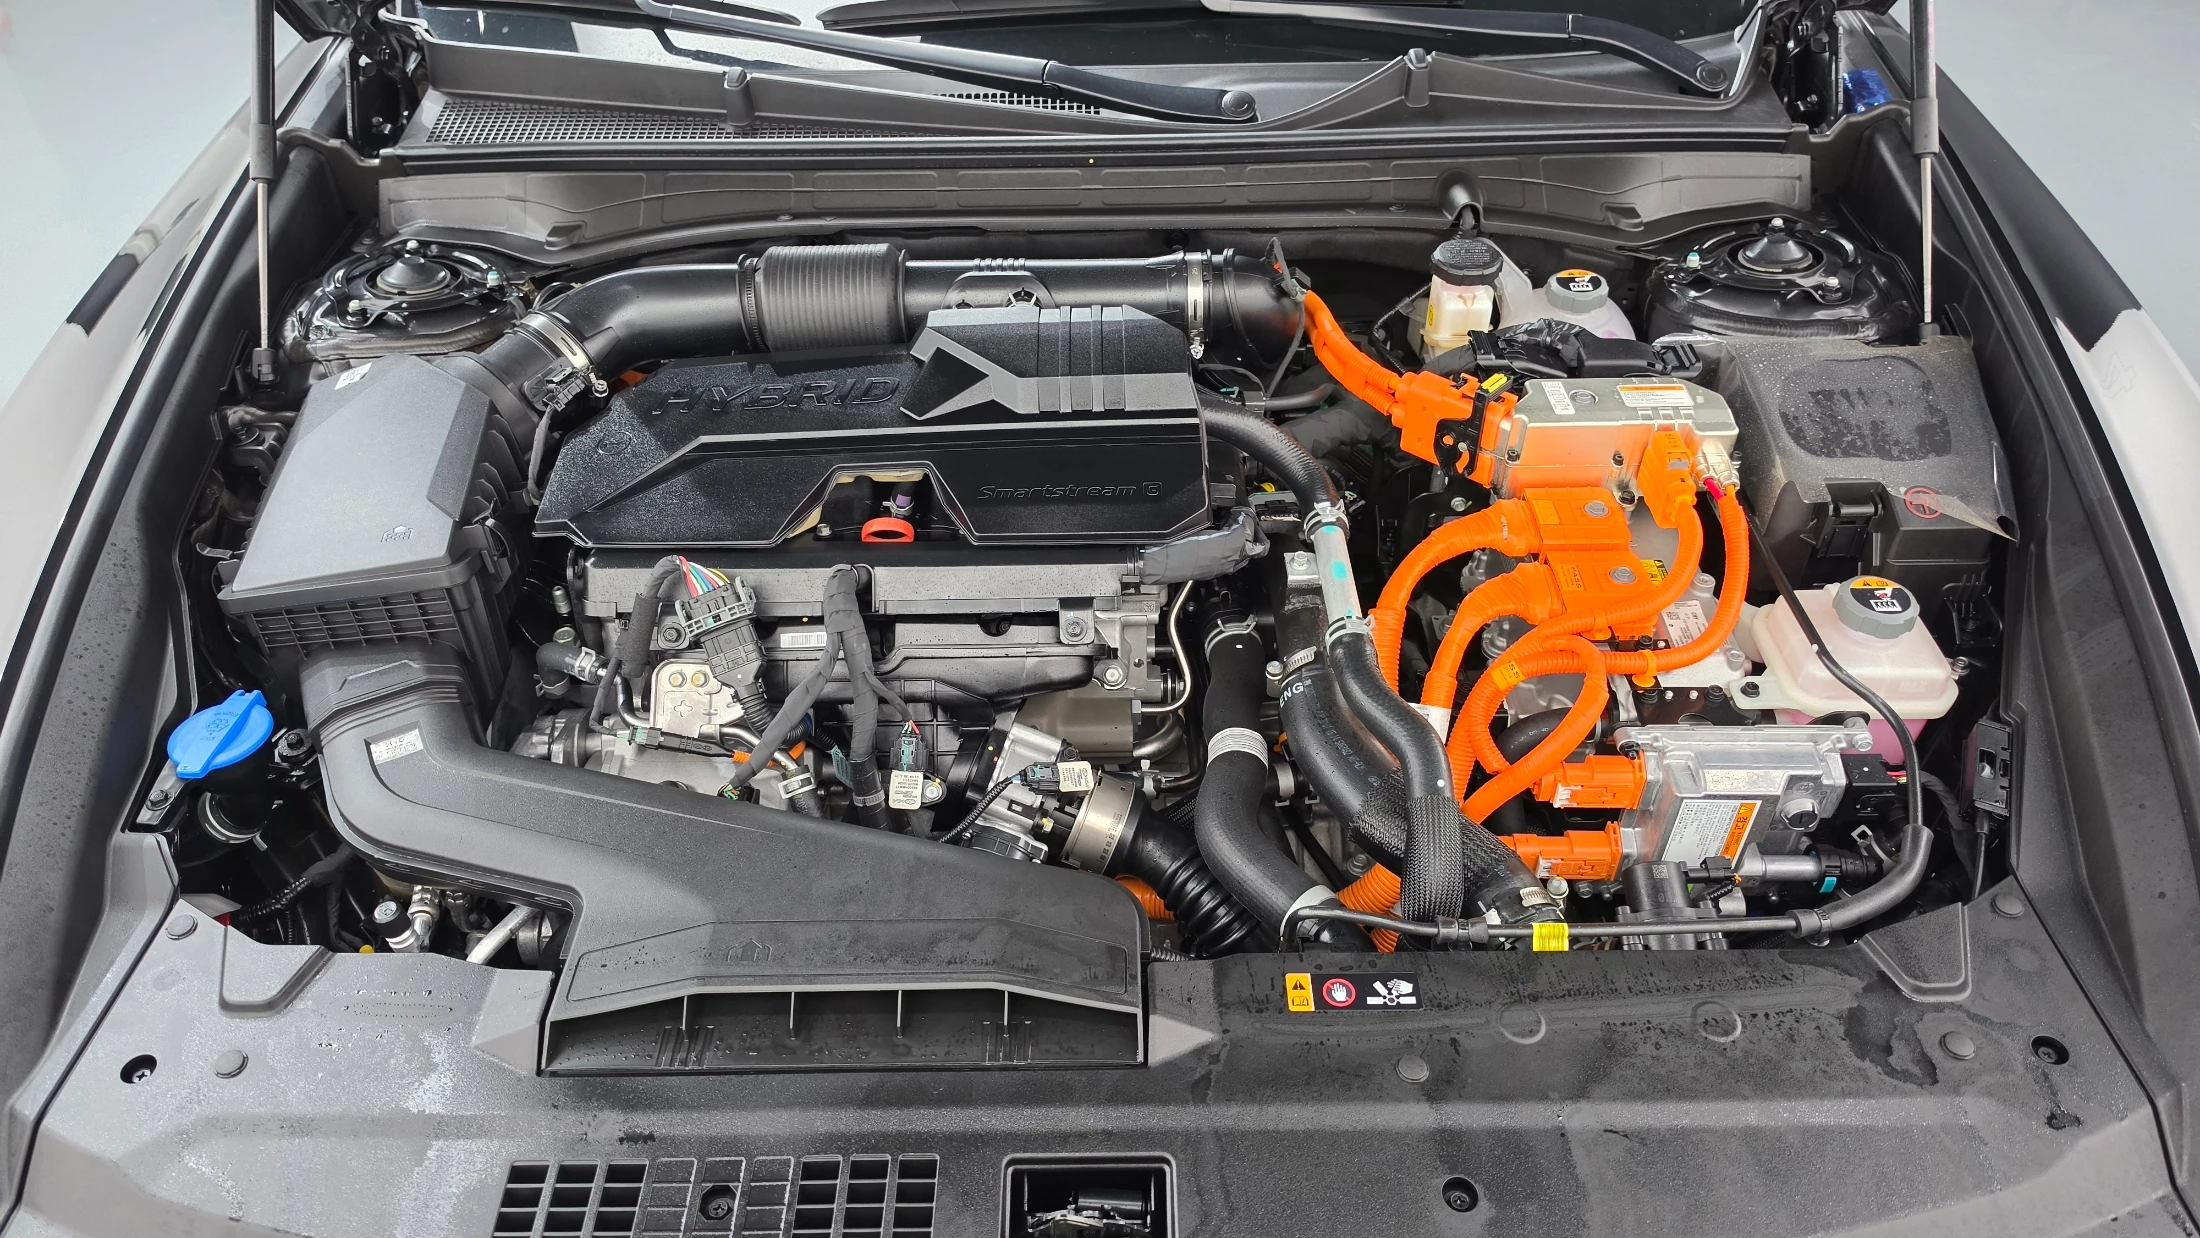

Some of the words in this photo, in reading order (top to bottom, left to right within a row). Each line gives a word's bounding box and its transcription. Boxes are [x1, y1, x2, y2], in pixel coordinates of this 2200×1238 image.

[652, 377, 900, 415] HYBRID
[977, 485, 1136, 499] Smartstream
[1280, 682, 1304, 708] ENG
[1734, 816, 1748, 831] 경고
